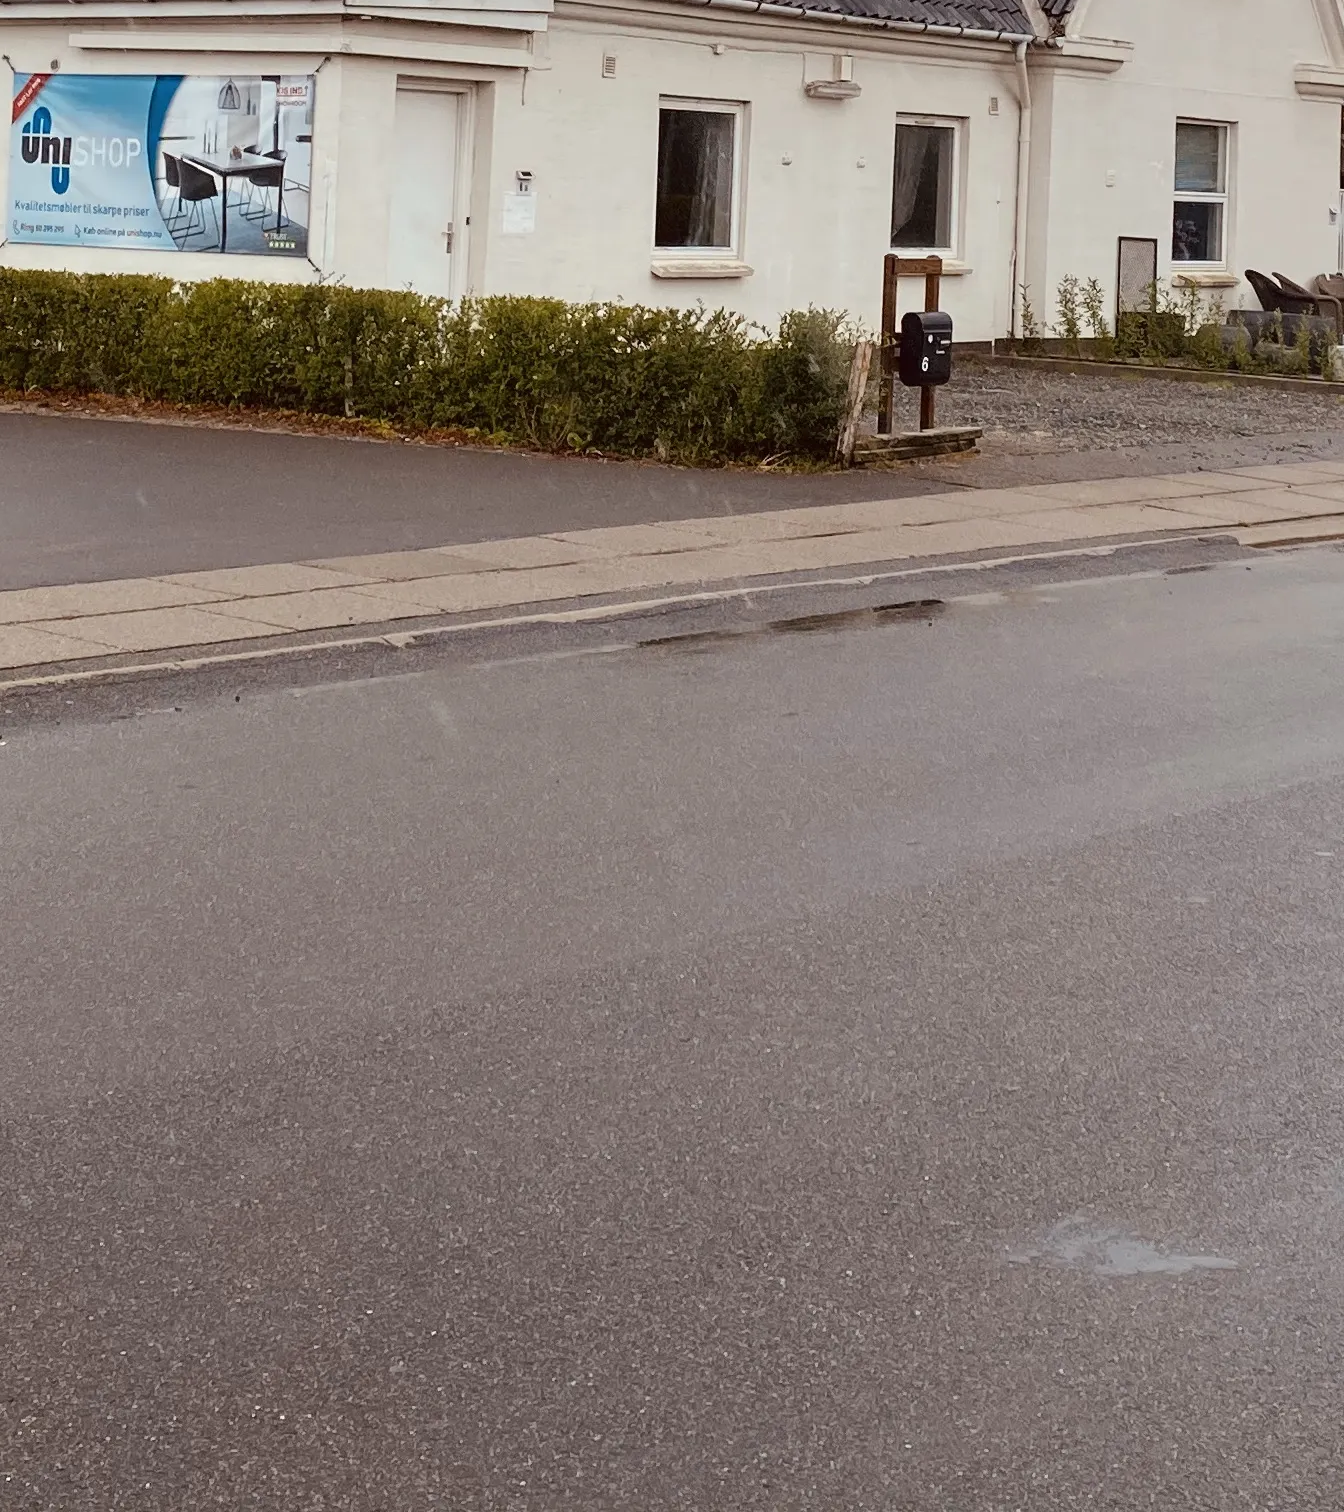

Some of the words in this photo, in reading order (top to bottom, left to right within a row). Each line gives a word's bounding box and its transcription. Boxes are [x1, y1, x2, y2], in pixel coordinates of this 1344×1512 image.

[15, 200, 82, 214] Kvalitetsmøbler
[83, 203, 92, 215] til
[93, 204, 122, 218] skarpe
[123, 205, 150, 219] priser
[97, 227, 116, 236] online
[921, 356, 929, 372] 6
